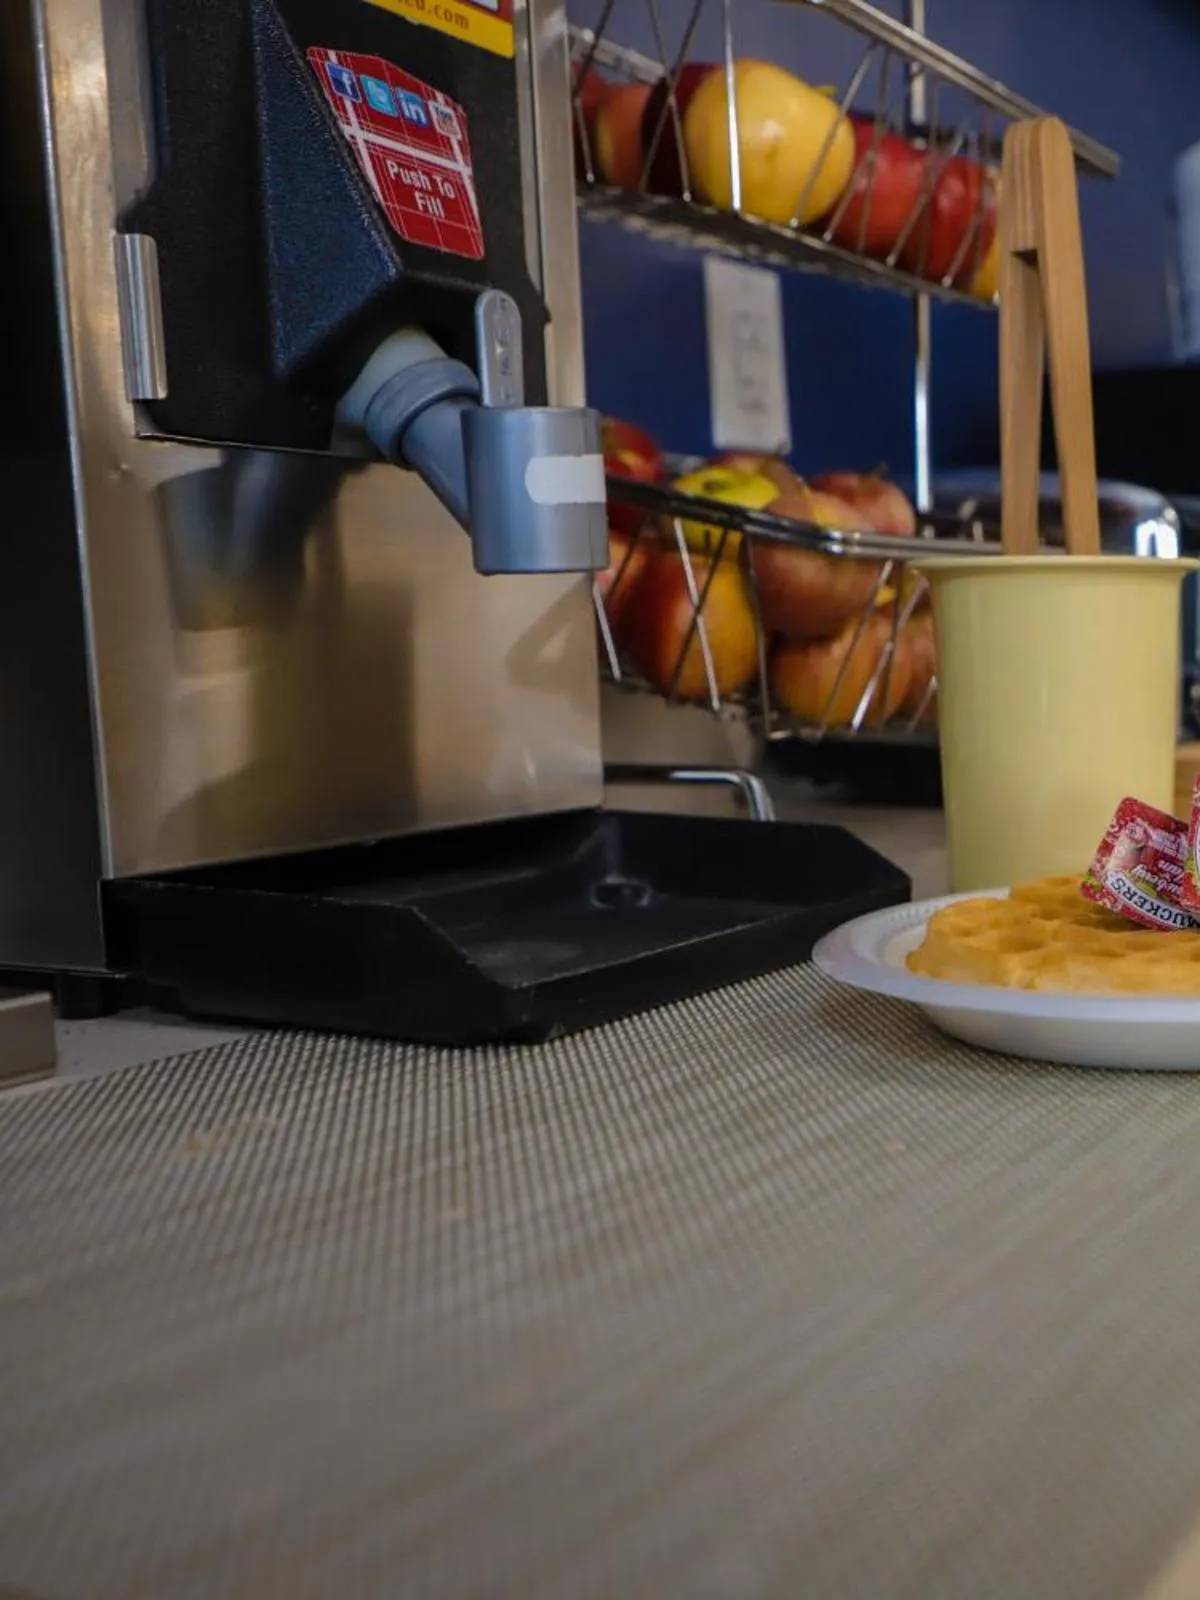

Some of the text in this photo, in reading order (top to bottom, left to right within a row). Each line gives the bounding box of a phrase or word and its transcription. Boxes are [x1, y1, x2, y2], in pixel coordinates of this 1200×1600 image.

[397, 0, 469, 30] ed.com
[386, 160, 456, 199] Push To
[414, 190, 445, 219] Fill
